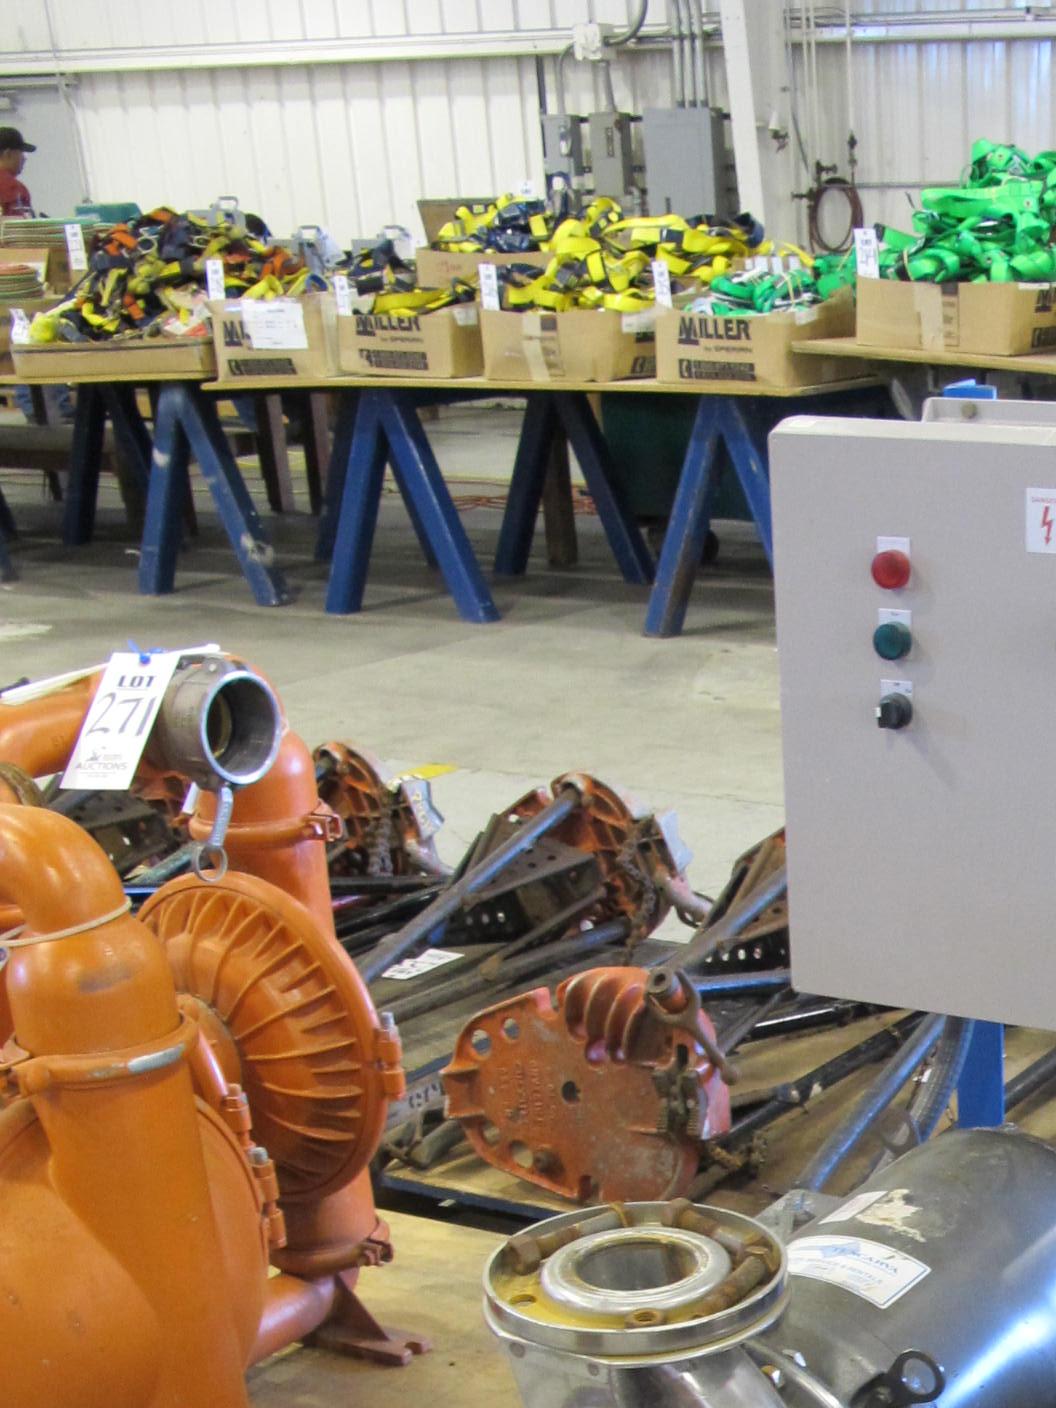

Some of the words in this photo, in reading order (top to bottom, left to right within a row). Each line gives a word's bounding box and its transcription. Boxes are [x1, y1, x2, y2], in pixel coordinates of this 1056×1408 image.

[678, 317, 752, 346] MILLER
[118, 675, 157, 688] LOT
[86, 691, 158, 737] 271
